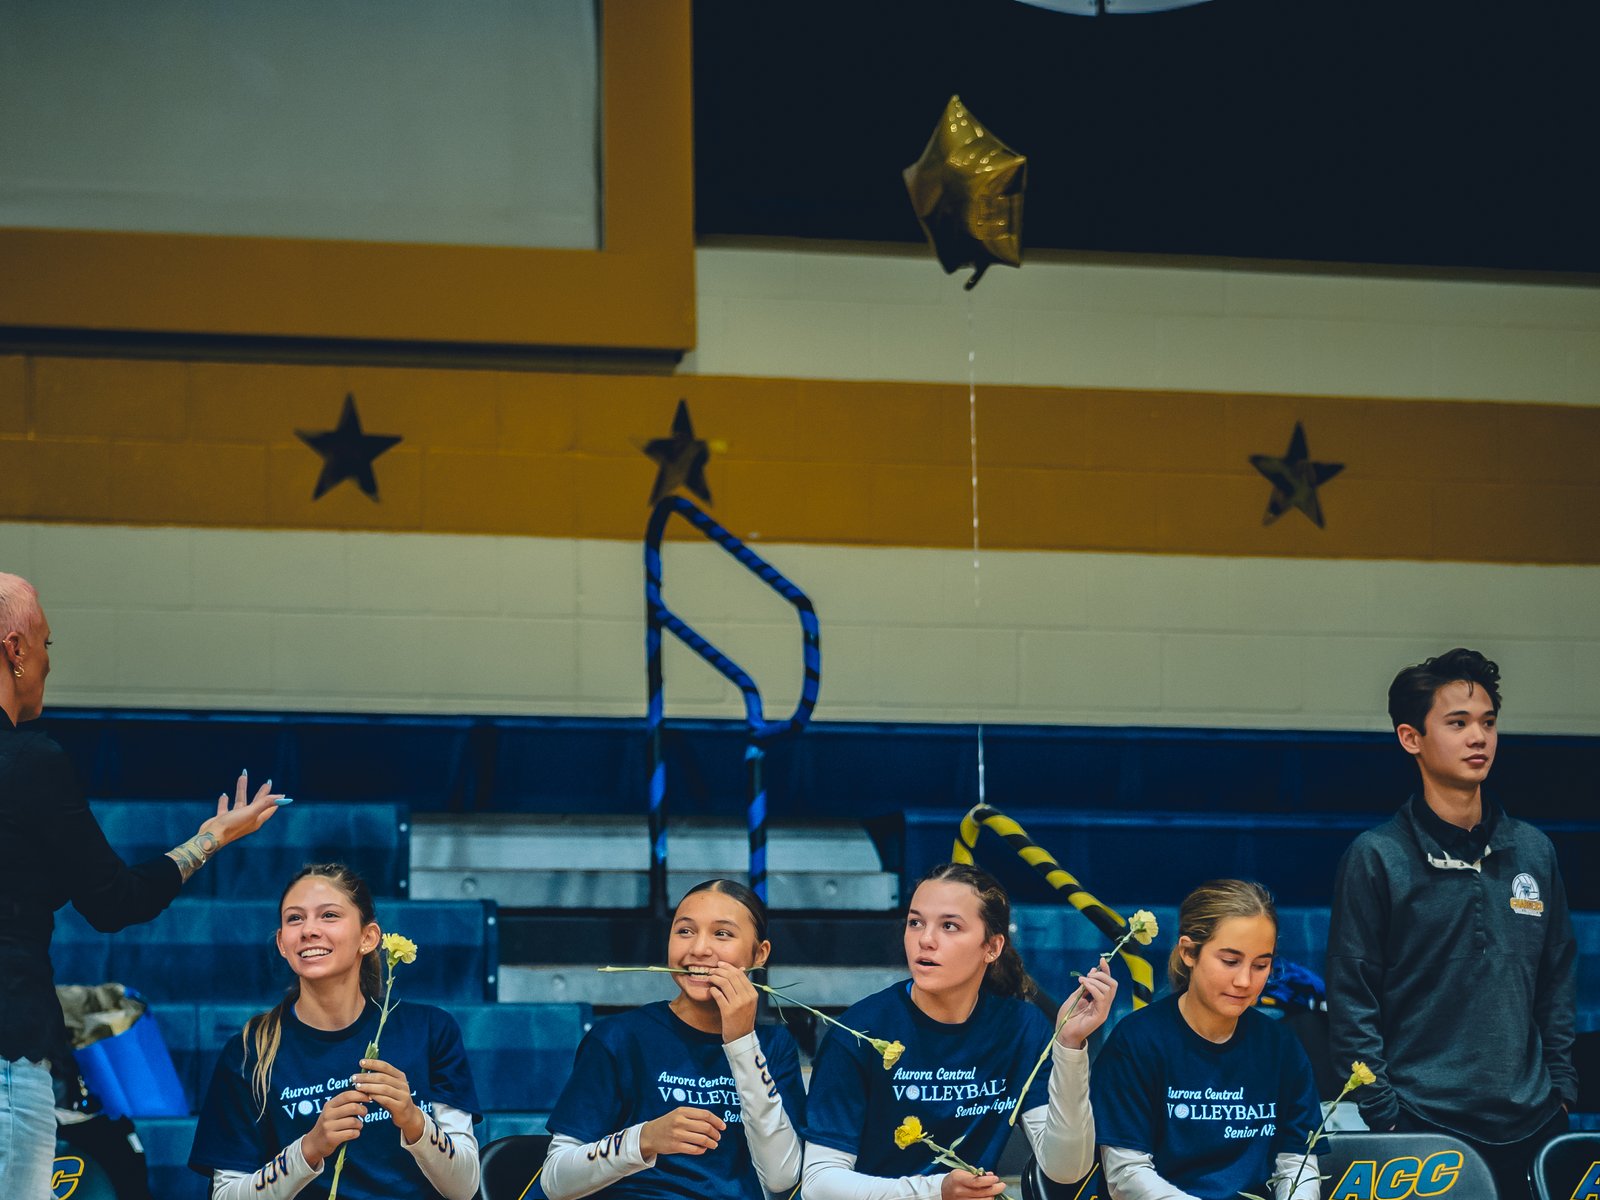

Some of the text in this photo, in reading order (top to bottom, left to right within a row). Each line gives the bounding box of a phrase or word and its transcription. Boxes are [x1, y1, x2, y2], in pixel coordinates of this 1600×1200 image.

[658, 1071, 737, 1088] Aurora Centra
[893, 1066, 976, 1081] Aurora Central
[280, 1085, 324, 1100] Aurora
[658, 1086, 741, 1106] VOLLEYB
[1204, 1086, 1244, 1100] Central
[357, 1107, 392, 1123] enio
[955, 1104, 990, 1119] Senior
[1224, 1125, 1258, 1139] Senior
